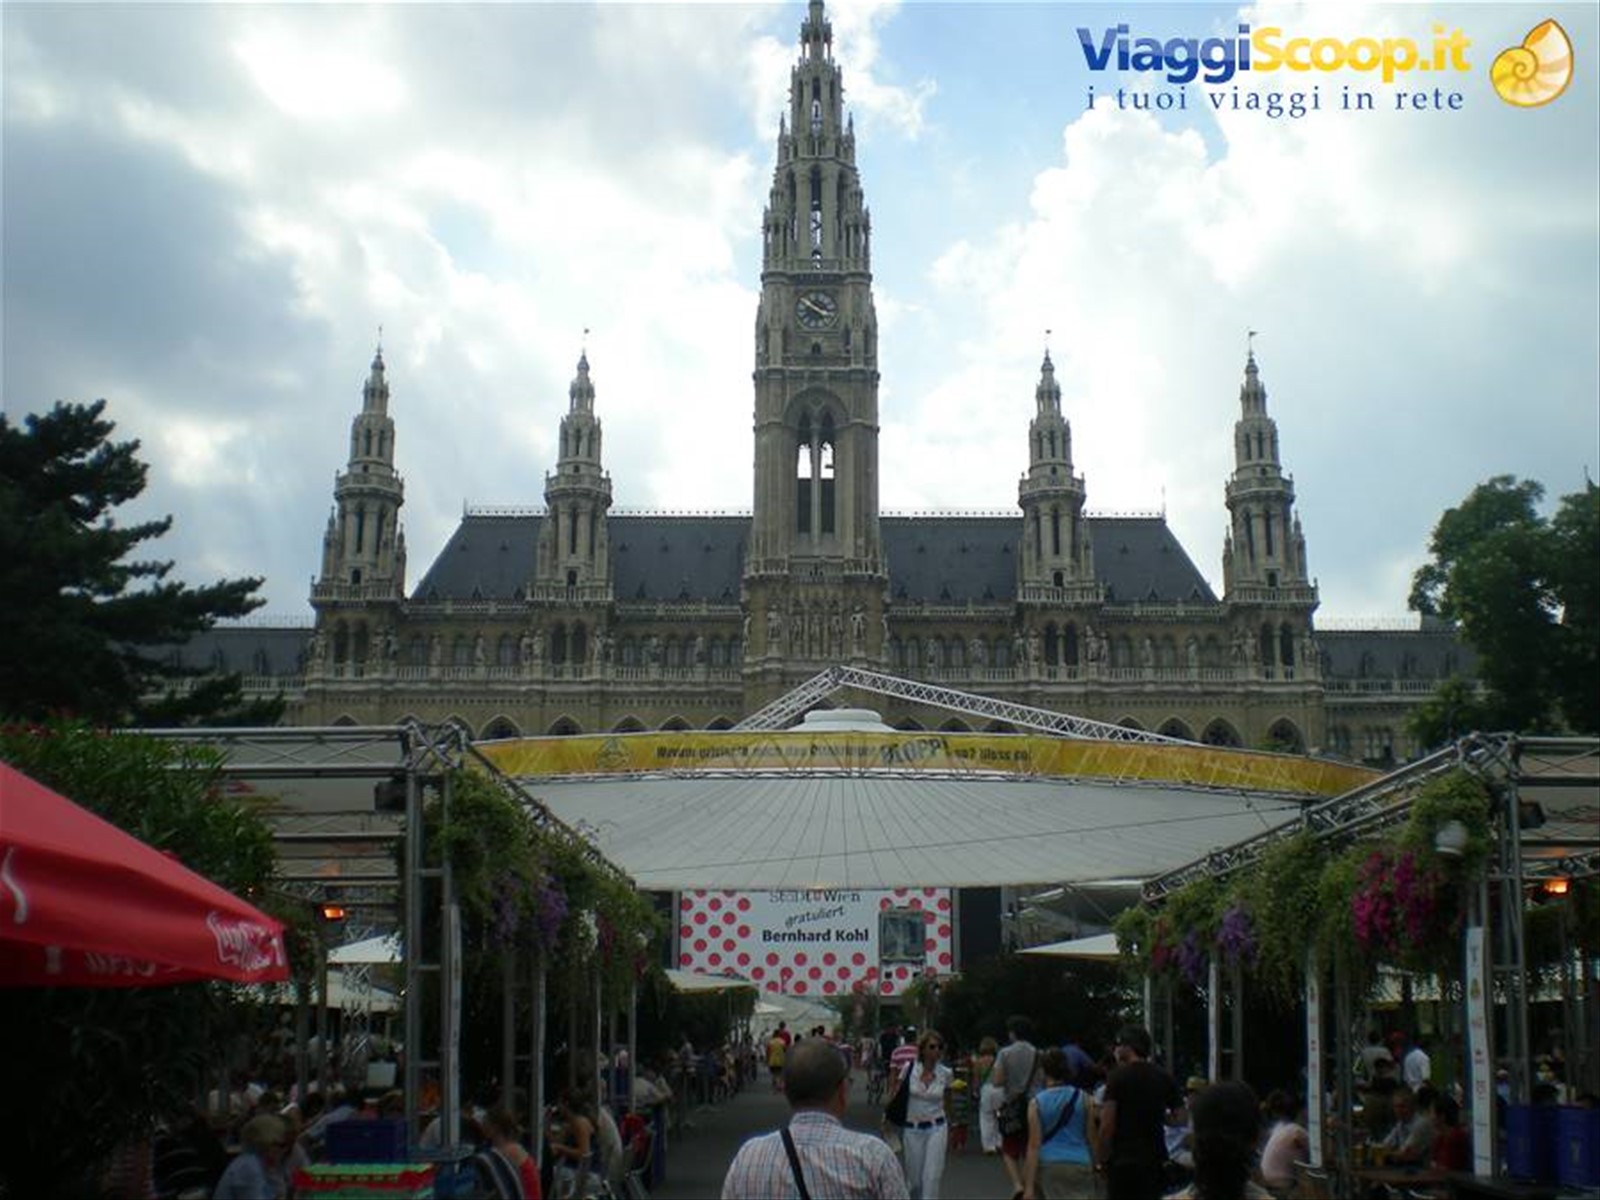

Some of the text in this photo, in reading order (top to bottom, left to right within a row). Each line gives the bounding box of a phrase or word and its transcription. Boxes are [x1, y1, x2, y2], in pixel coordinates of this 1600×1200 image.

[785, 905, 844, 928] gratuliert
[762, 928, 869, 942] Bernhard Kohl
